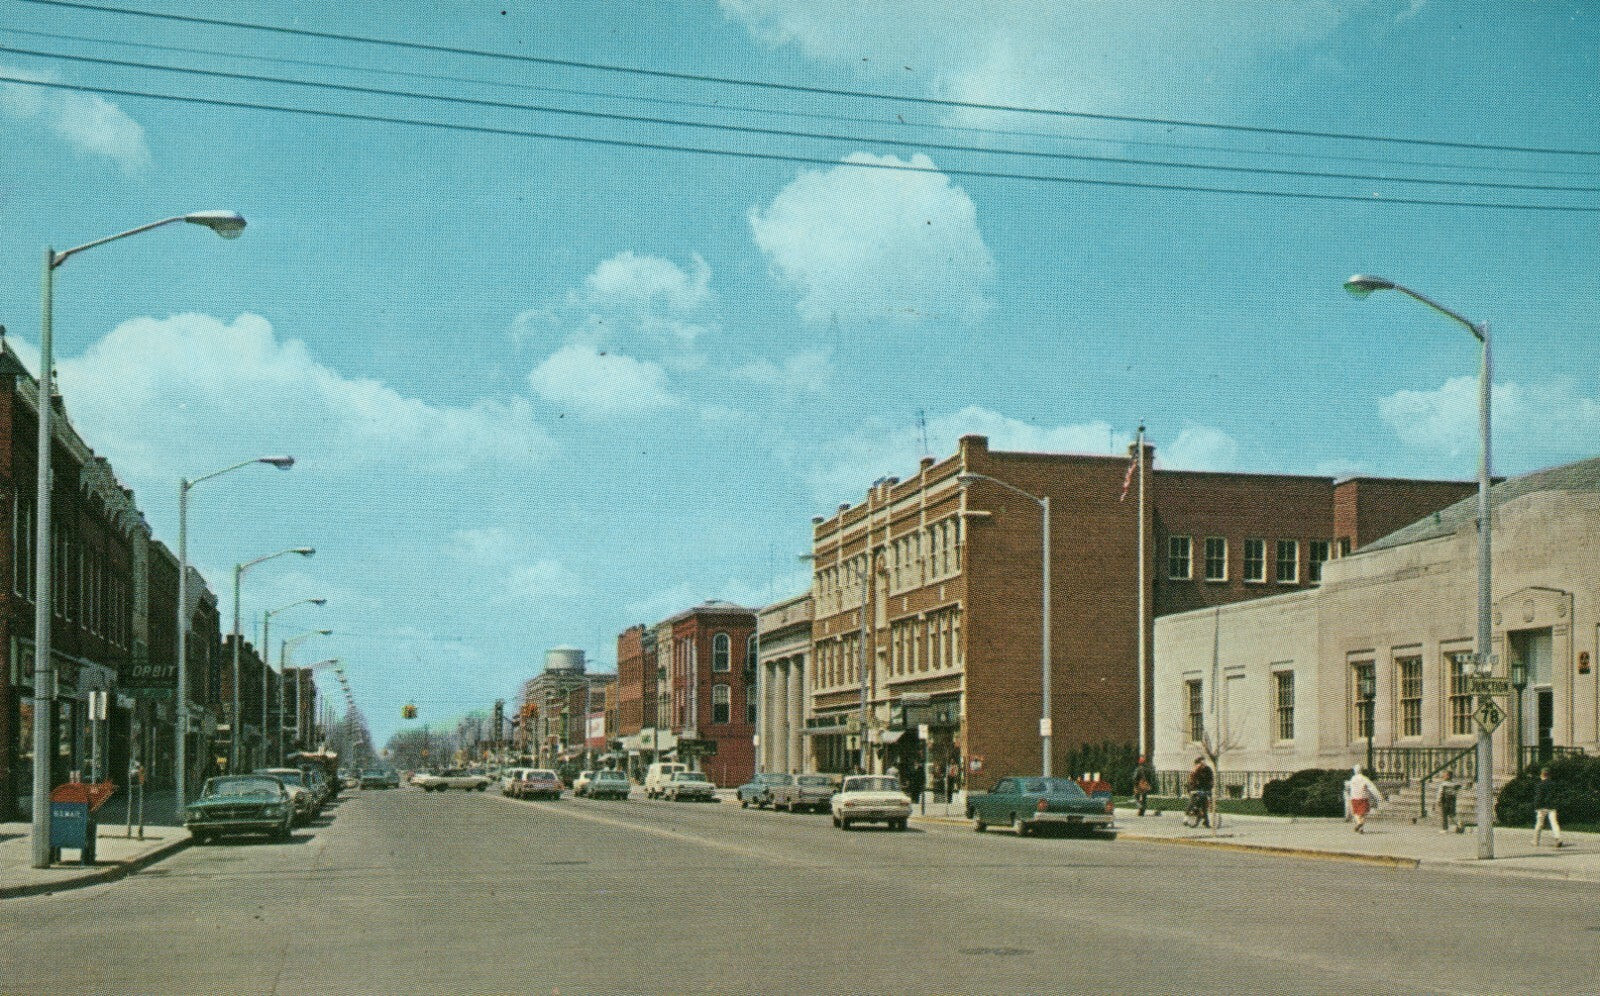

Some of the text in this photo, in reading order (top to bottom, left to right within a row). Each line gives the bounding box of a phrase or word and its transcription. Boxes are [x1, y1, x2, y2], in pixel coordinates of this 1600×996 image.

[132, 664, 177, 677] ORBIT
[1471, 681, 1509, 692] JUNCTION
[1480, 709, 1499, 724] 78
